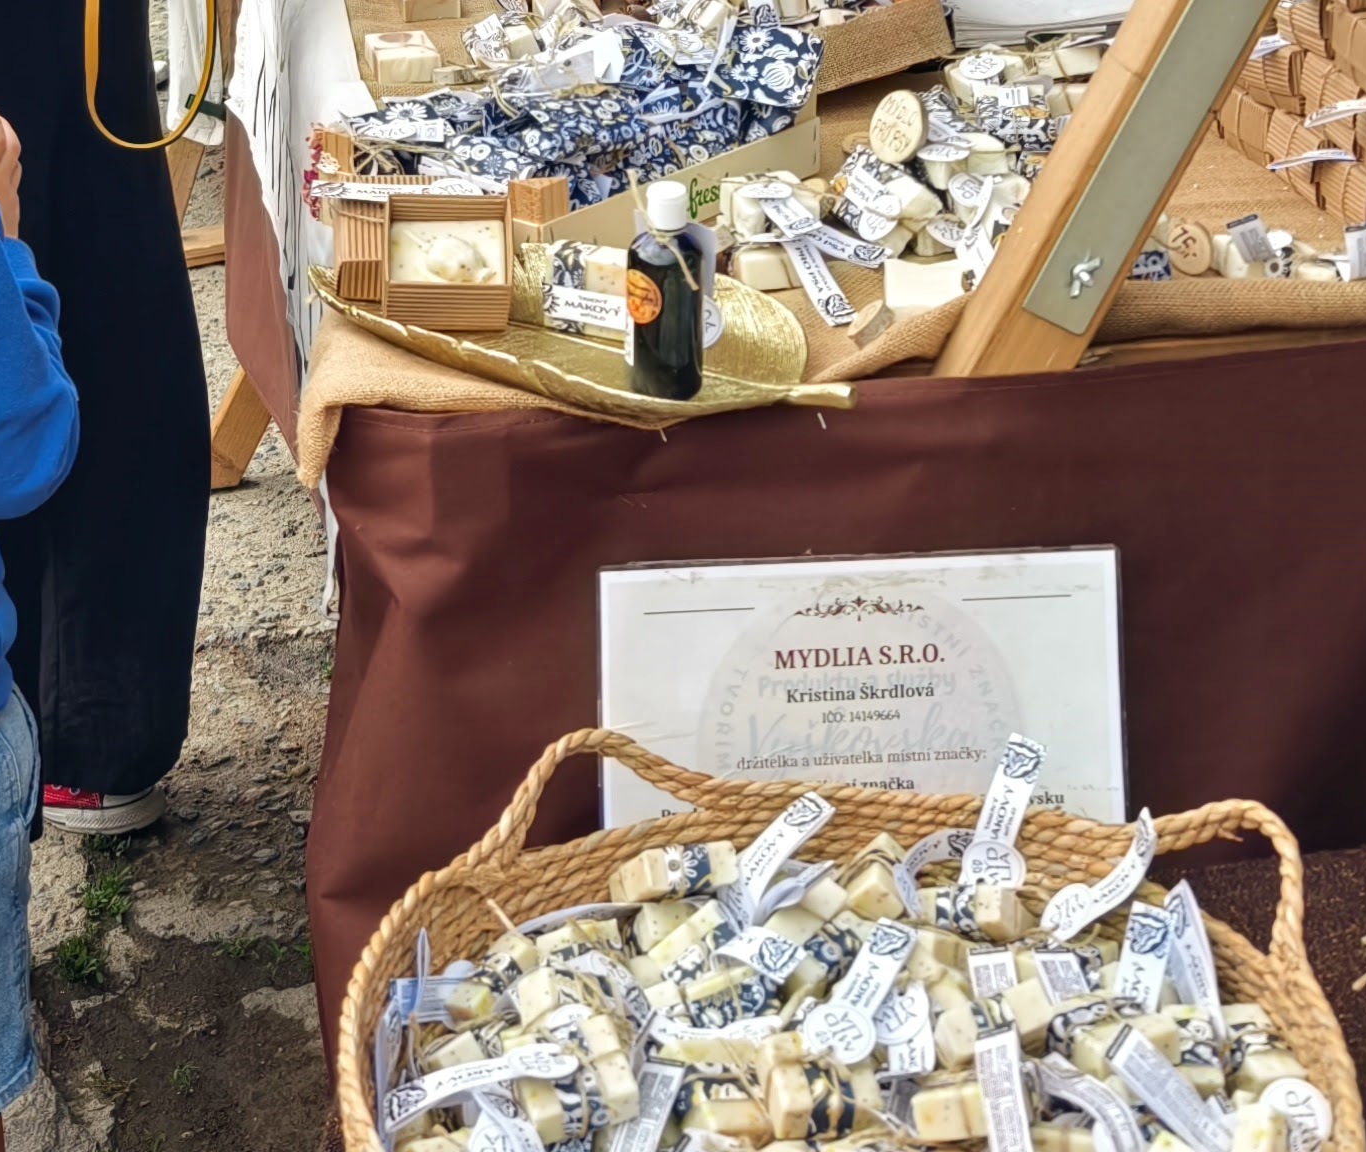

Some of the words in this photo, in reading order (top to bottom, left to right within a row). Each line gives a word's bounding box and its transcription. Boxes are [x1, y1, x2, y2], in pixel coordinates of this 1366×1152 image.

[880, 96, 919, 127] MÝDLO
[687, 176, 724, 219] fres
[564, 299, 621, 317] MAKOVÝ
[774, 646, 873, 670] MYDLIA
[878, 643, 946, 666] S.R.O.
[786, 685, 856, 704] Kristina
[860, 682, 935, 701] Škrdlová
[849, 709, 901, 723] 14149664
[736, 756, 798, 771] držitelka
[801, 757, 810, 768] a
[813, 750, 884, 767] uživatelka
[887, 748, 931, 764] místní
[934, 745, 987, 763] značky:
[850, 960, 880, 1007] AKOVÝ
